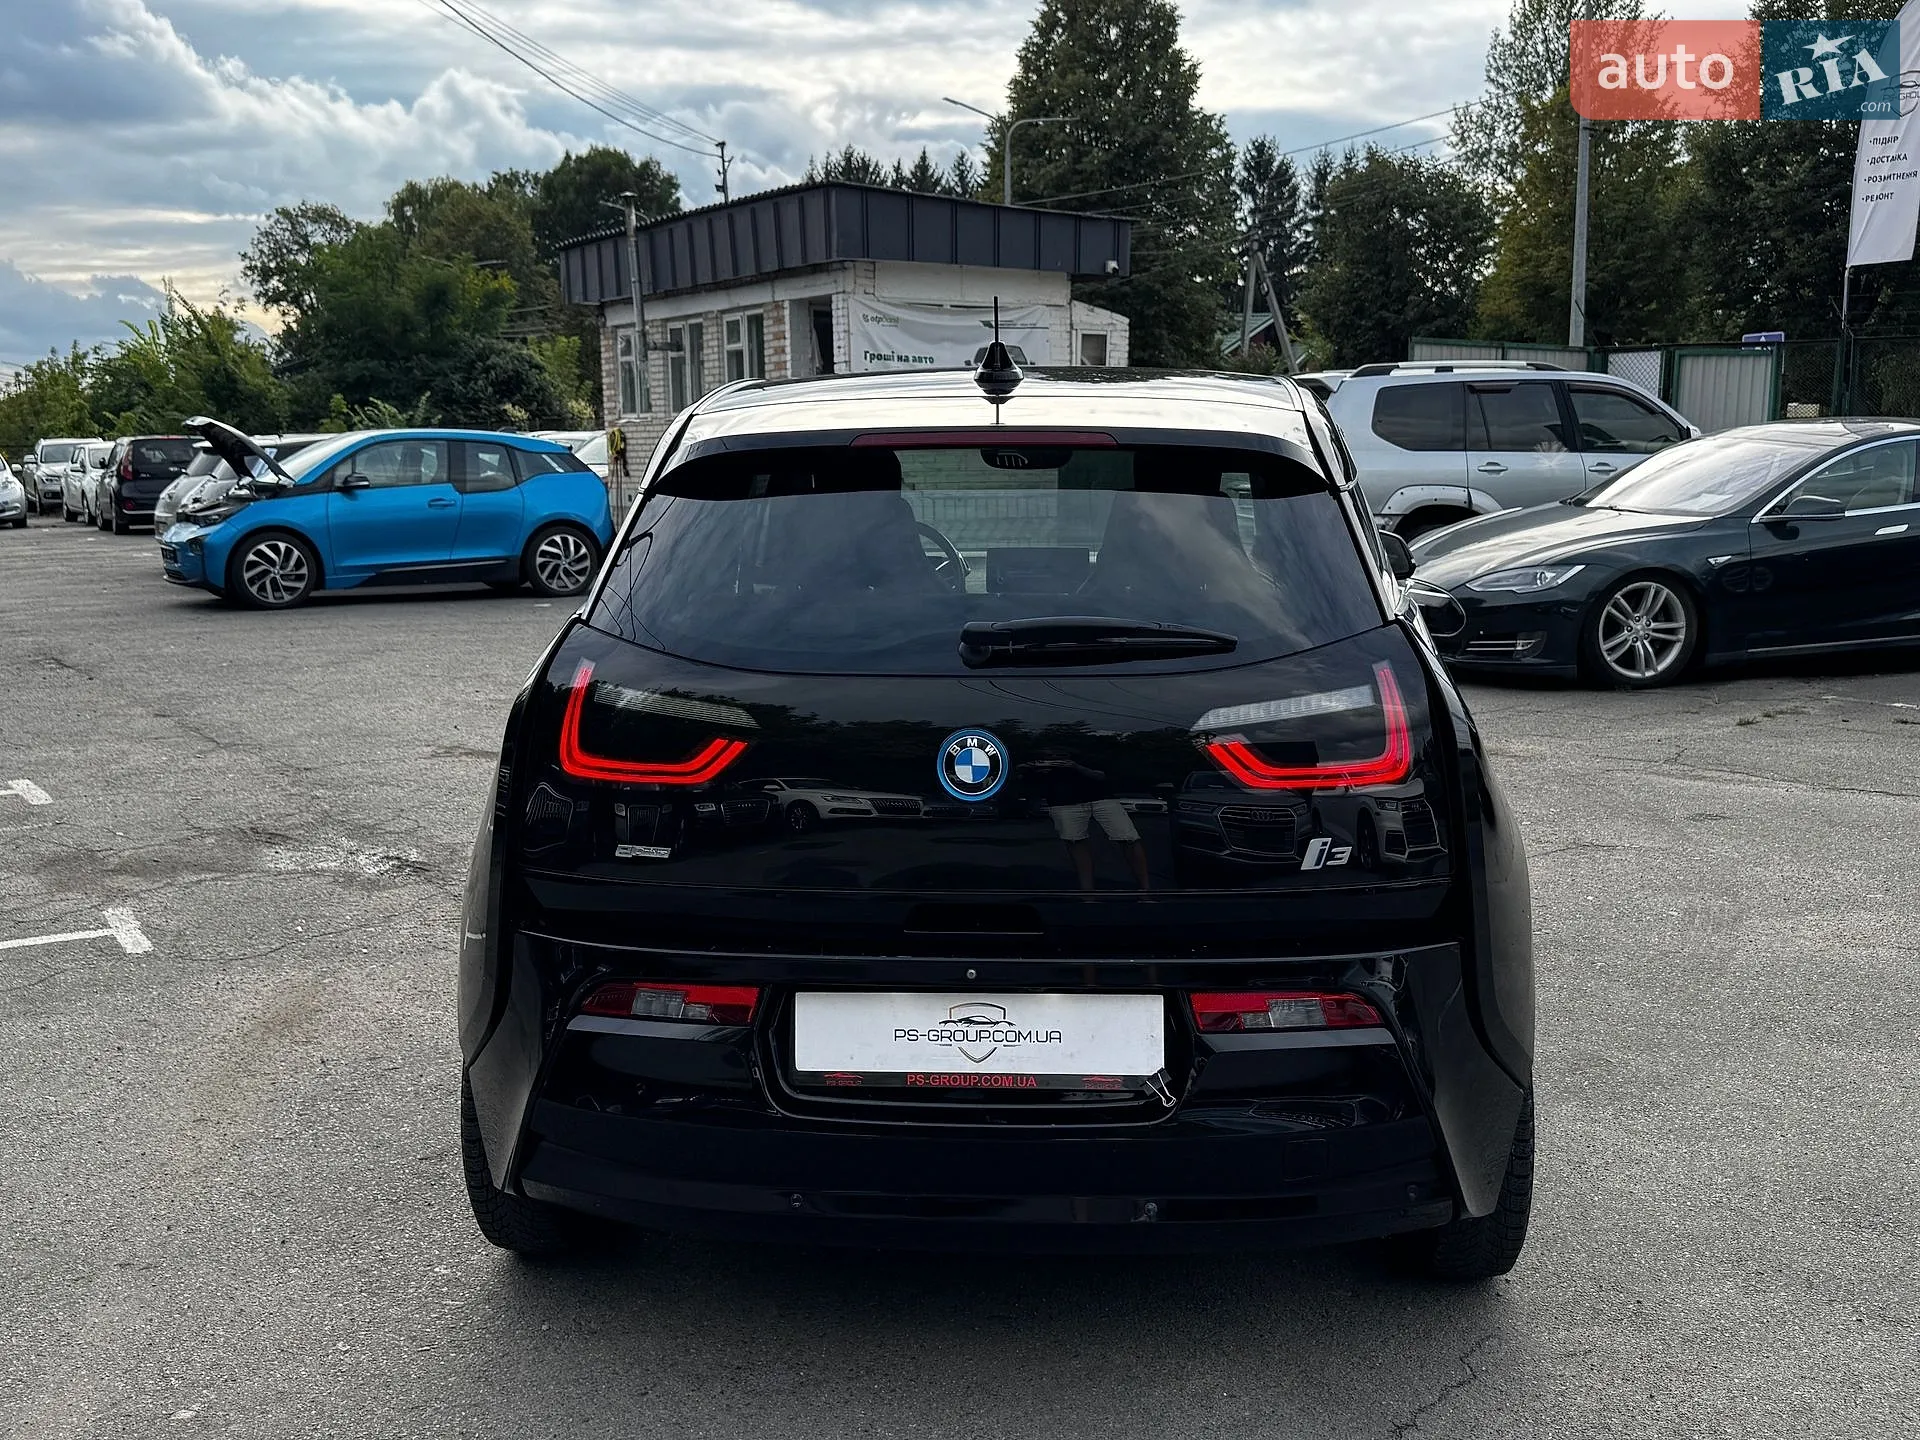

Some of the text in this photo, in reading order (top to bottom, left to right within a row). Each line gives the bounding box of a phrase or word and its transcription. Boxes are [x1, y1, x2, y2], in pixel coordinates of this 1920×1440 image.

[864, 350, 935, 364] Гроші на авто
[949, 738, 997, 757] BMW
[1300, 837, 1353, 871] i3
[893, 1028, 1062, 1044] PS-GROUP.COM.UA
[906, 1074, 1037, 1088] PS-GROUP.COM.UA
